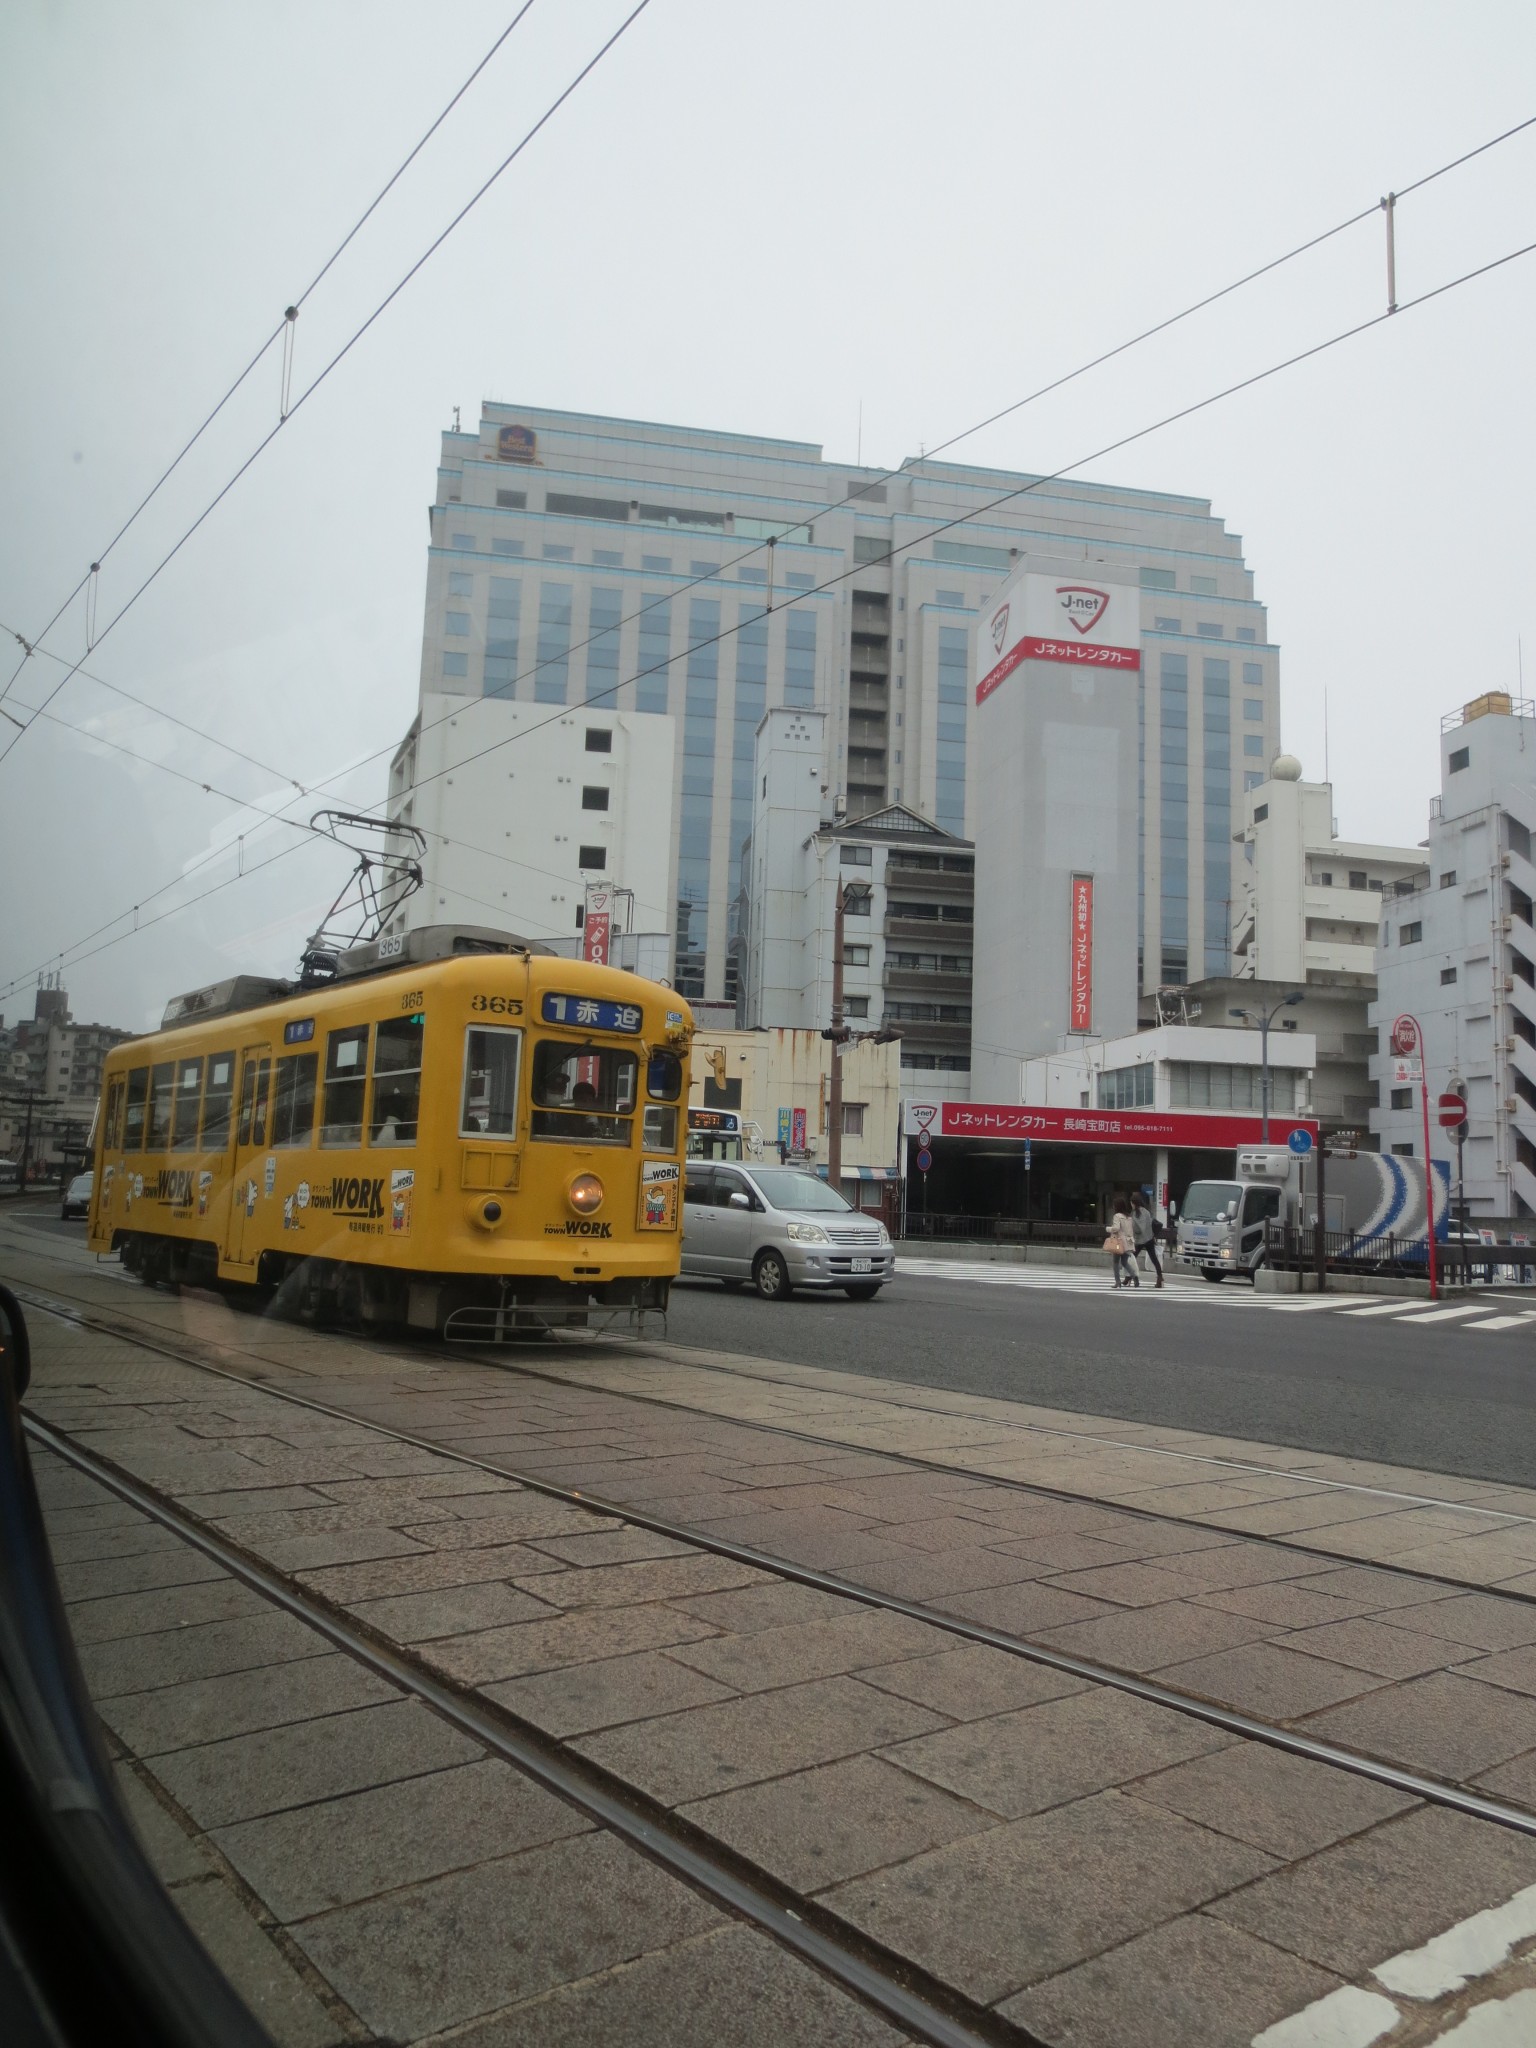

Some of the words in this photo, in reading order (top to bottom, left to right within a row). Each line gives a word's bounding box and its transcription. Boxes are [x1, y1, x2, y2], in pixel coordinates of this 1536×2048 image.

[1034, 643, 1132, 662] Jネットレンタカー
[588, 916, 608, 924] ご予約
[380, 936, 400, 956] 365
[402, 991, 423, 1009] 365
[471, 994, 524, 1016] 365
[549, 996, 567, 1020] 1
[576, 1000, 640, 1030] 赤迫
[948, 1112, 1058, 1129] Jネットレンタカー
[1063, 1117, 1121, 1133] 長崎宝町店
[653, 1168, 679, 1179] WORK
[159, 1170, 194, 1207] WORK
[311, 1195, 332, 1209] TOWN
[332, 1178, 385, 1218] WORK
[544, 1227, 566, 1235] TOWN
[566, 1220, 612, 1239] WORK
